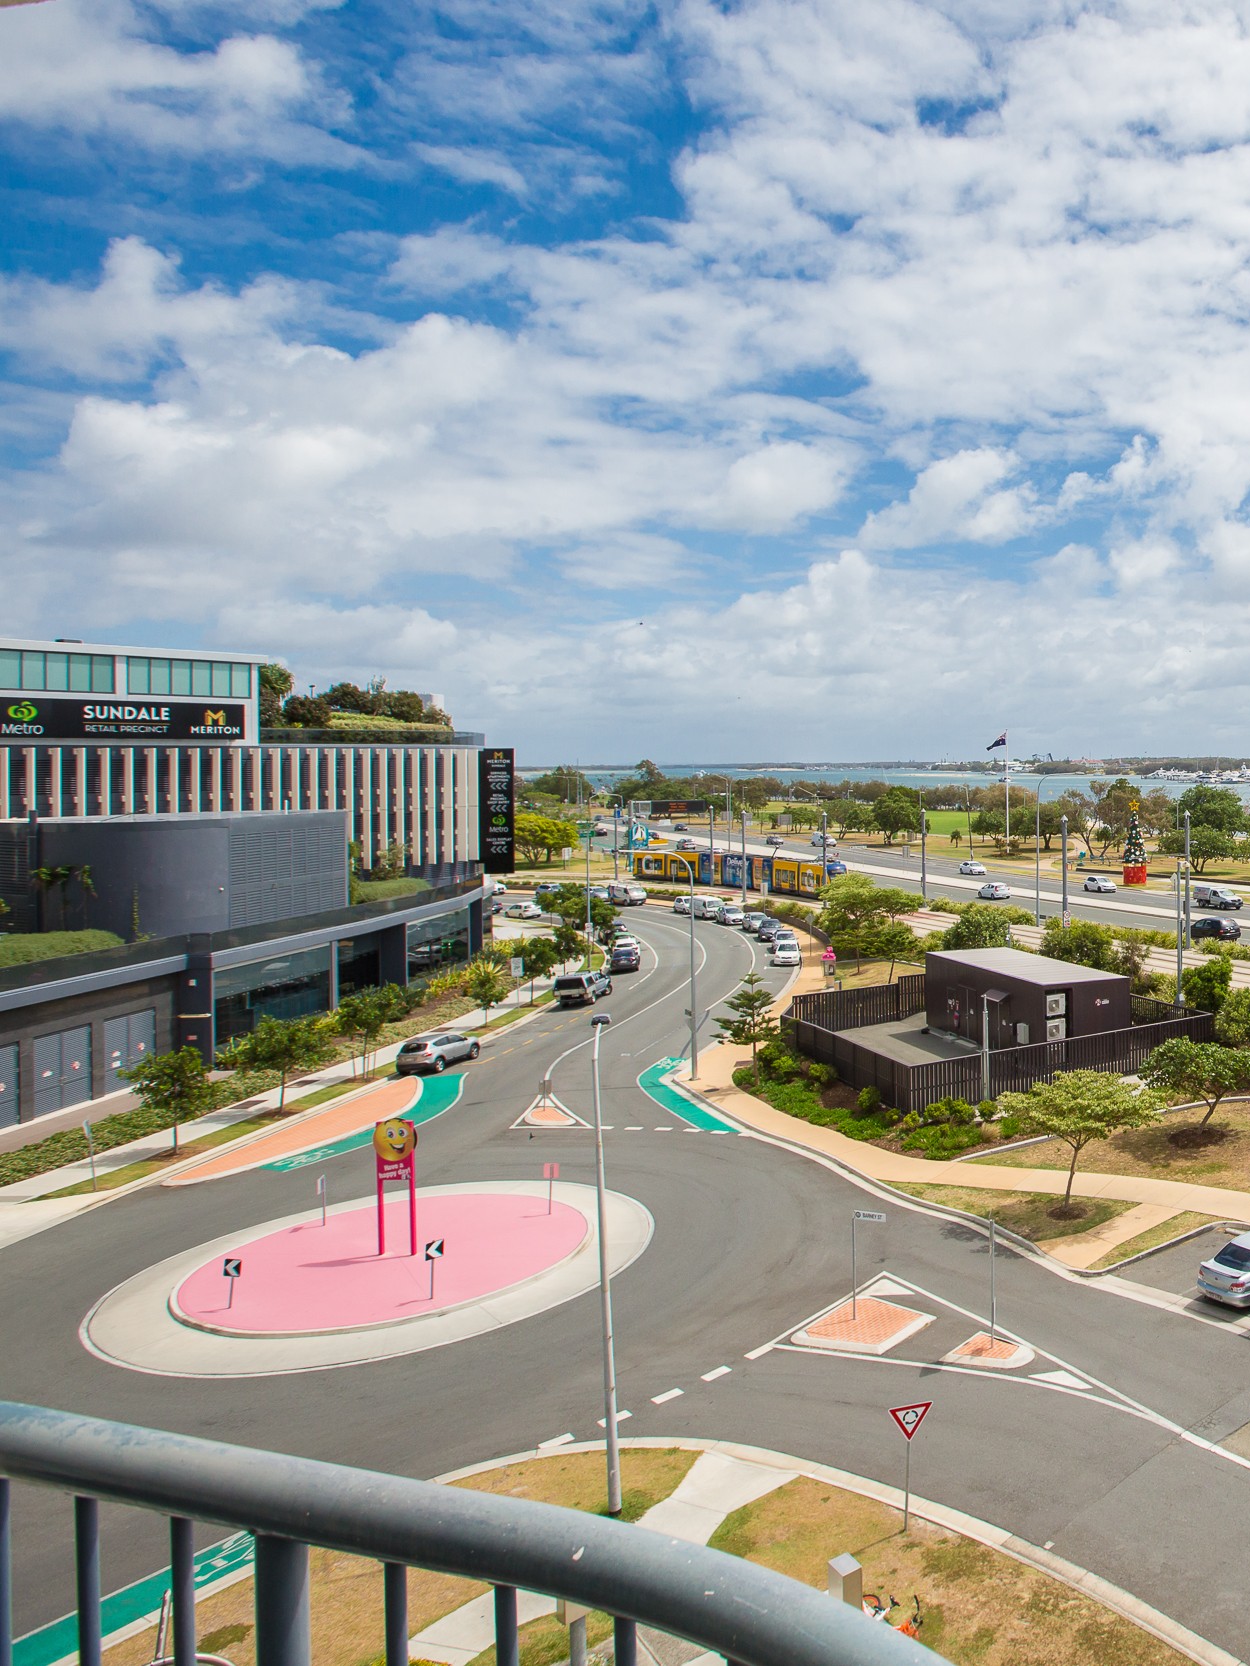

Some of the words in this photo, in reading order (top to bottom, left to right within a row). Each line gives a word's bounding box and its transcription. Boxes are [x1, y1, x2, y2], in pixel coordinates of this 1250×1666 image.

[83, 705, 170, 720] SUNDALE
[1, 723, 44, 735] Metro
[120, 725, 168, 733] PRECINCT
[190, 726, 240, 734] MERITON
